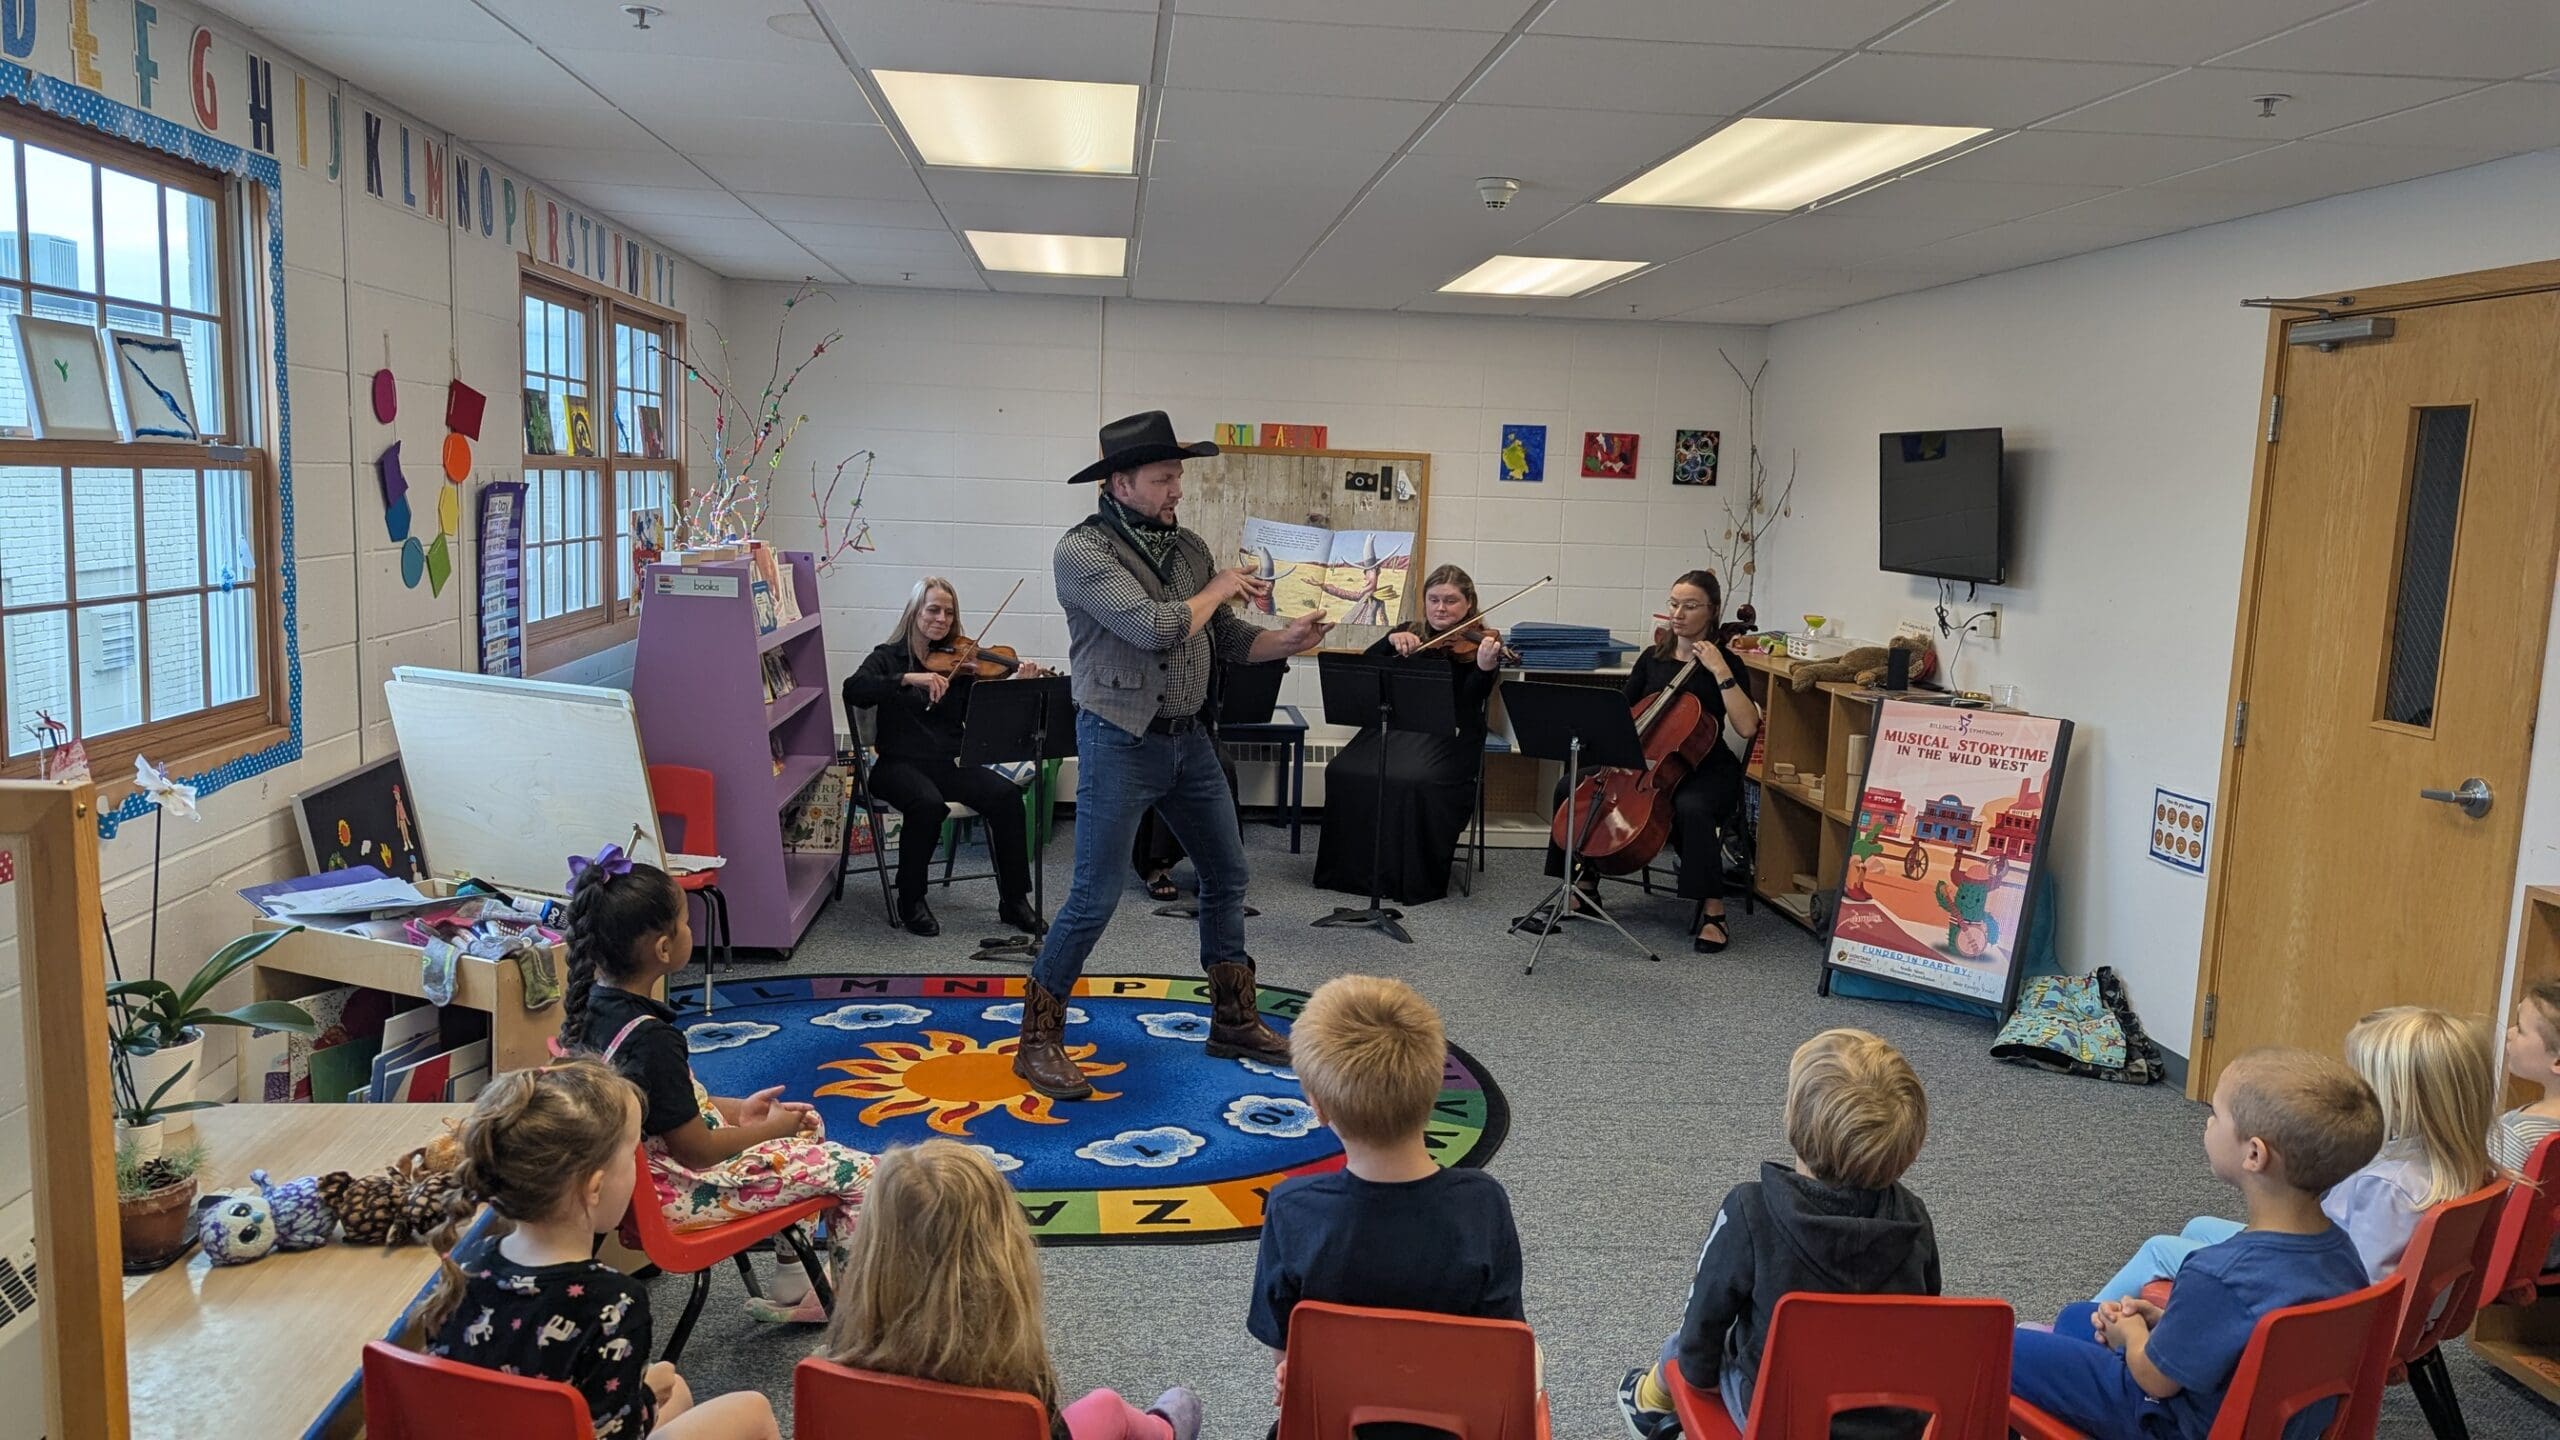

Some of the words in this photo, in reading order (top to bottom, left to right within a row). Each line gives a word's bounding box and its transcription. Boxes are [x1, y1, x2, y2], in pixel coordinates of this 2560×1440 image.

[72, 0, 102, 90] E
[135, 0, 158, 109] F
[192, 30, 218, 131] G
[249, 54, 274, 155] H
[298, 76, 308, 168] I
[328, 95, 340, 180] J
[365, 111, 383, 199] K
[402, 126, 416, 208] L
[426, 139, 444, 221] M
[456, 155, 471, 231] N
[479, 166, 493, 236] O
[504, 178, 515, 245] P
[548, 201, 559, 264] R
[566, 210, 576, 269] S
[580, 216, 590, 275] T
[596, 222, 605, 281] U
[614, 233, 622, 288] V
[627, 240, 640, 296] W
[642, 249, 651, 300] X
[656, 253, 663, 303] Y
[668, 259, 675, 307] Z
[694, 578, 720, 591] books
[1884, 729, 1949, 749] MUSICAL
[1957, 739, 2048, 763] STORYTIME
[1897, 745, 1911, 756] IN
[1918, 748, 1941, 760] THE
[1950, 752, 1982, 766] WILD
[1989, 757, 2028, 773] WEST
[1873, 795, 1894, 804] STORE
[1862, 945, 1903, 961] FUNDED
[1907, 955, 1918, 963] IN
[1922, 959, 1950, 971] PART
[752, 986, 794, 999] L
[840, 979, 889, 993] M
[943, 980, 988, 994] N
[1112, 981, 1146, 994] P
[861, 1011, 884, 1022] 6
[1173, 1021, 1200, 1031] 8
[704, 1031, 734, 1041] 5
[1132, 1200, 1191, 1224] Z
